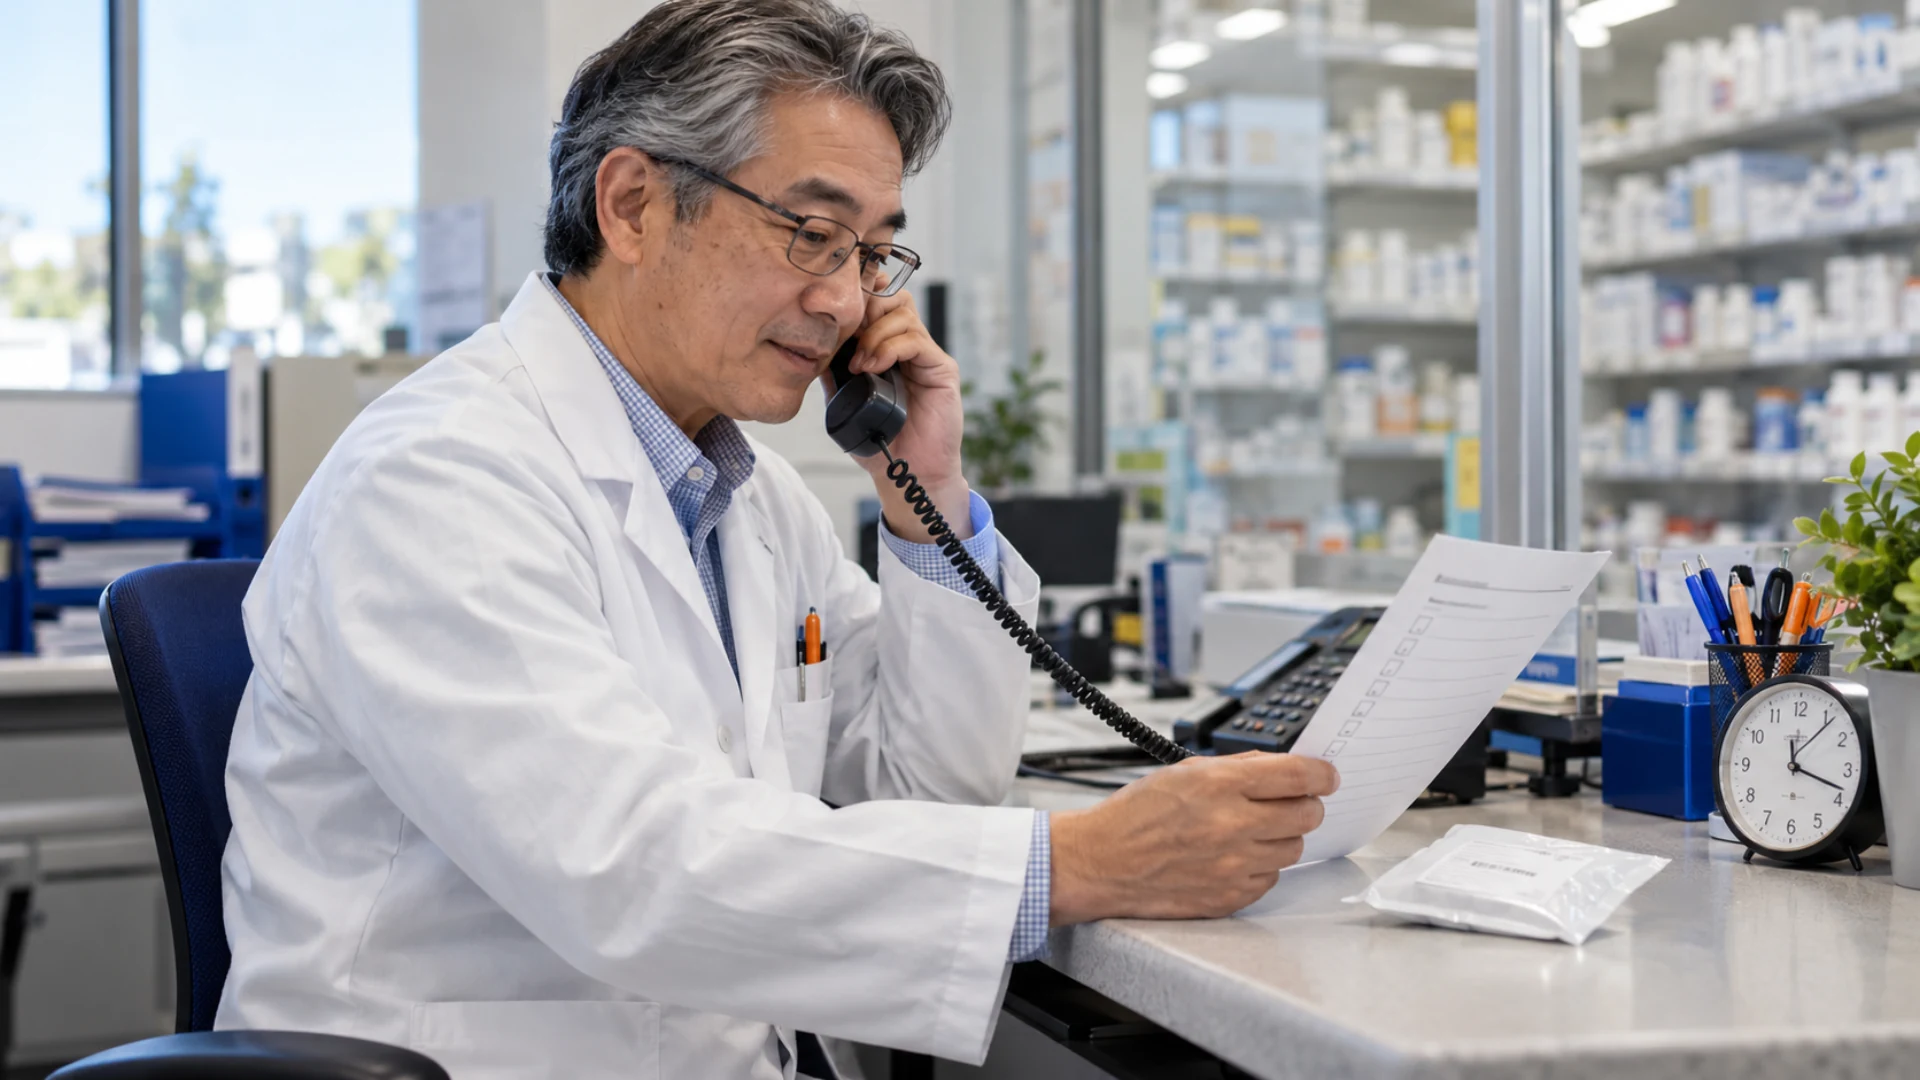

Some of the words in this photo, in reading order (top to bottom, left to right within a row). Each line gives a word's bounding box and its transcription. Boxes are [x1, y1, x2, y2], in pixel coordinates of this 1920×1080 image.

[1770, 709, 1781, 723] 11
[1794, 701, 1808, 717] 12
[1824, 710, 1829, 725] 1
[1752, 729, 1764, 744] 10
[1837, 732, 1847, 747] 2
[1742, 757, 1750, 772] 9
[1843, 762, 1852, 778] 3
[1746, 787, 1755, 803] 8
[1833, 792, 1843, 807] 4
[1763, 810, 1771, 825] 7
[1813, 813, 1823, 829] 5
[1787, 819, 1796, 835] 6
